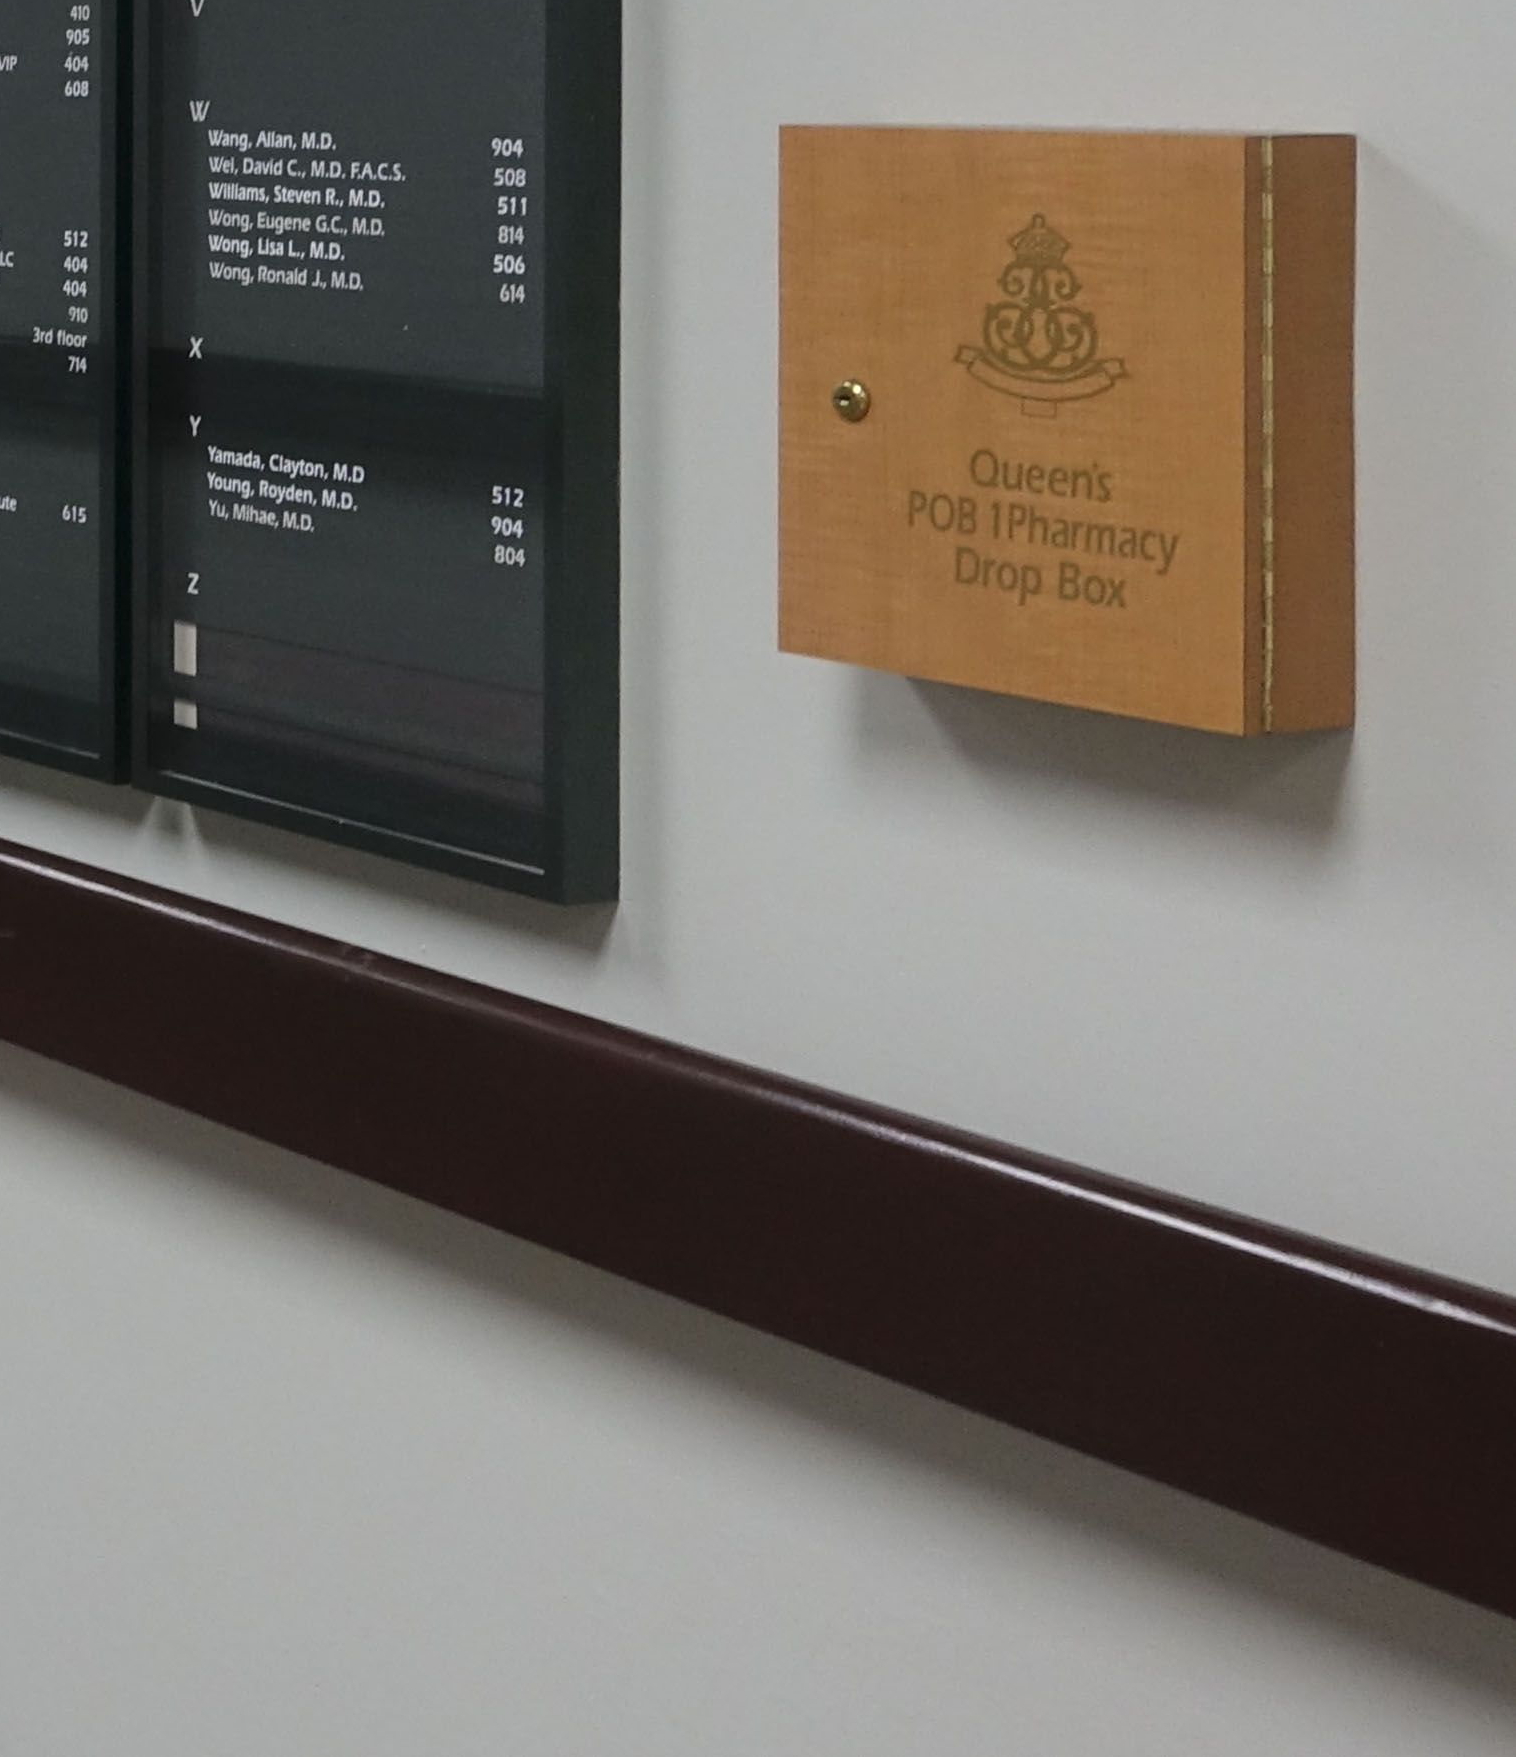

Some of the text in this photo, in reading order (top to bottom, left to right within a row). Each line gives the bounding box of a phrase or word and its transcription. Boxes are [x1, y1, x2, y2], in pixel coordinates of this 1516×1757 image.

[64, 80, 88, 96] 608
[190, 101, 209, 123] W
[208, 129, 523, 157] Wang, Allan, M.D. 904
[209, 182, 526, 215] Williams, Steven R., M.D. 511
[64, 230, 88, 247] 512
[33, 326, 53, 344] 3rd
[57, 329, 87, 347] floor
[189, 337, 203, 359] X
[189, 416, 201, 437] Y
[207, 445, 264, 471] Yamada,
[269, 454, 328, 480] Clayton,
[492, 485, 523, 507] 512
[970, 448, 1111, 502] Queen's
[62, 504, 86, 523] 615
[908, 490, 976, 534] POB
[187, 573, 199, 594] Z
[955, 547, 1126, 608] Drop Box
